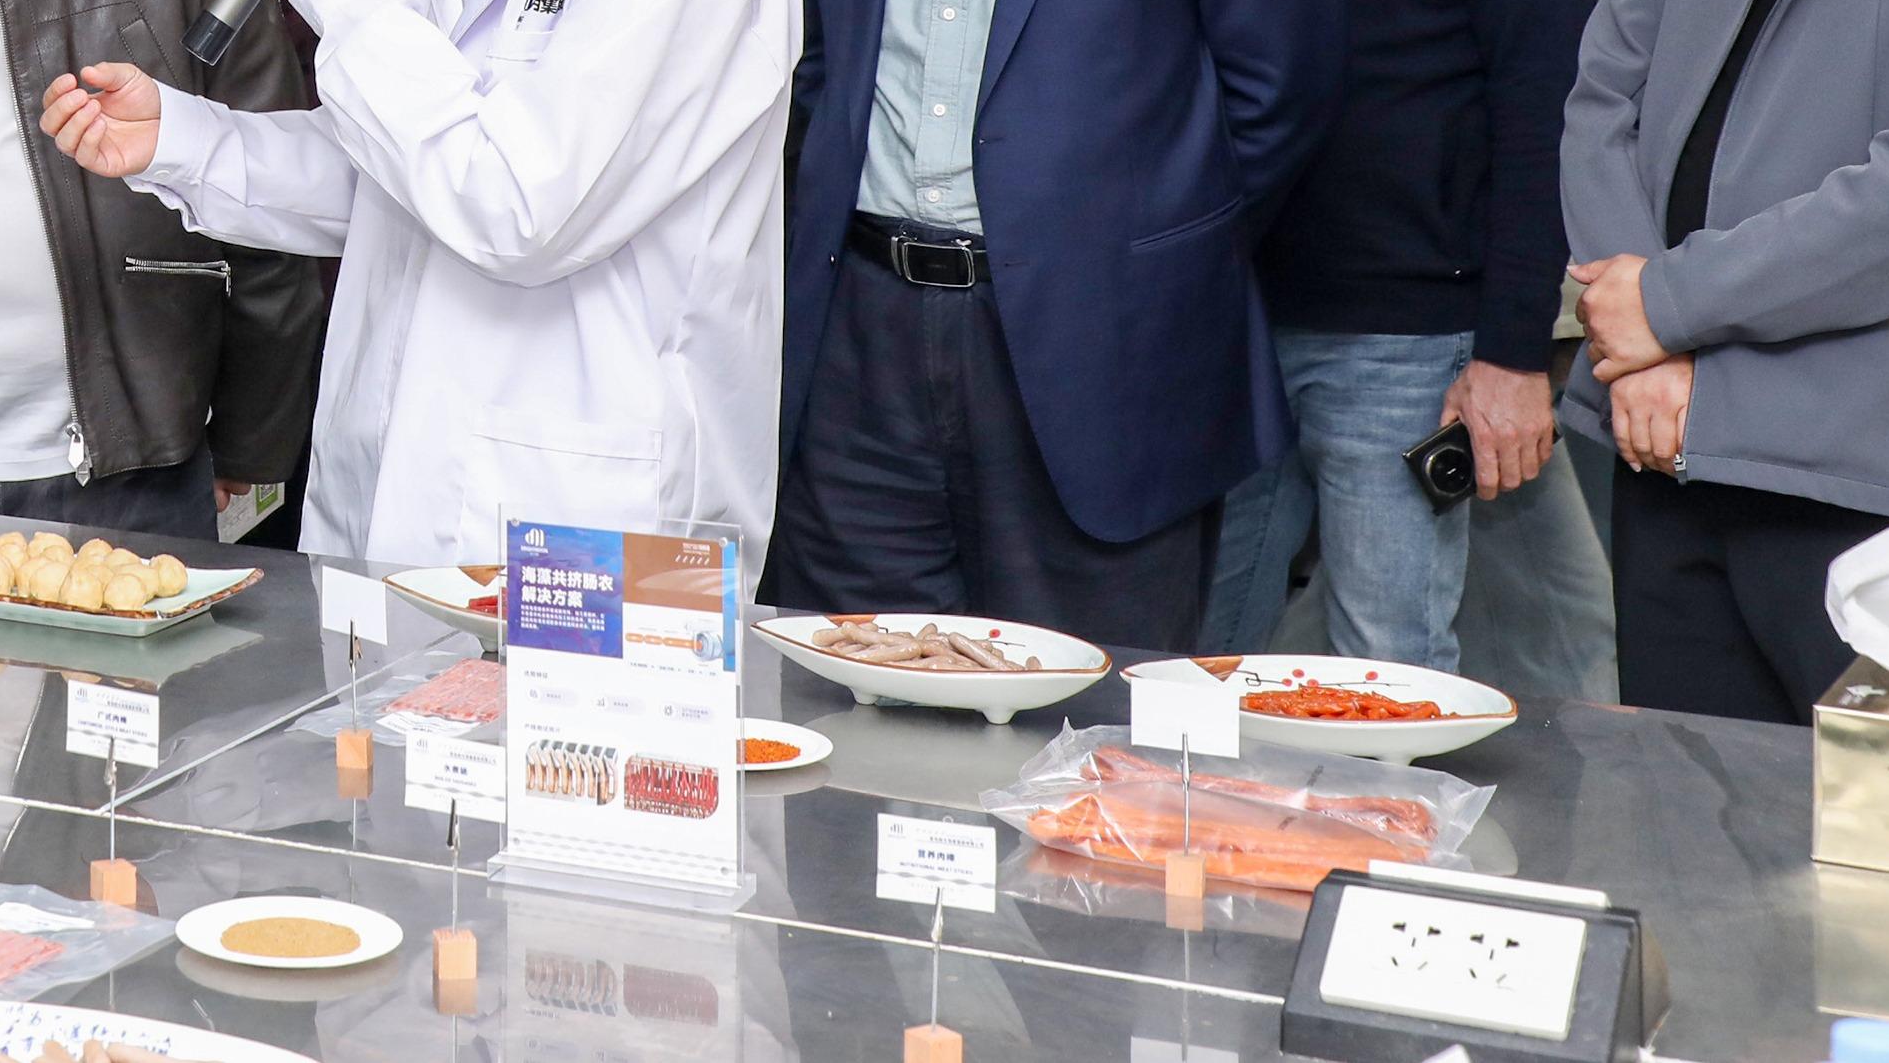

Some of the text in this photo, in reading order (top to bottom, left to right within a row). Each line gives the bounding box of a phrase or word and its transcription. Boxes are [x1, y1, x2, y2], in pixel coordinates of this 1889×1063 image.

[520, 565, 614, 592] 海藻共挤肠衣
[520, 586, 583, 609] 解决方案
